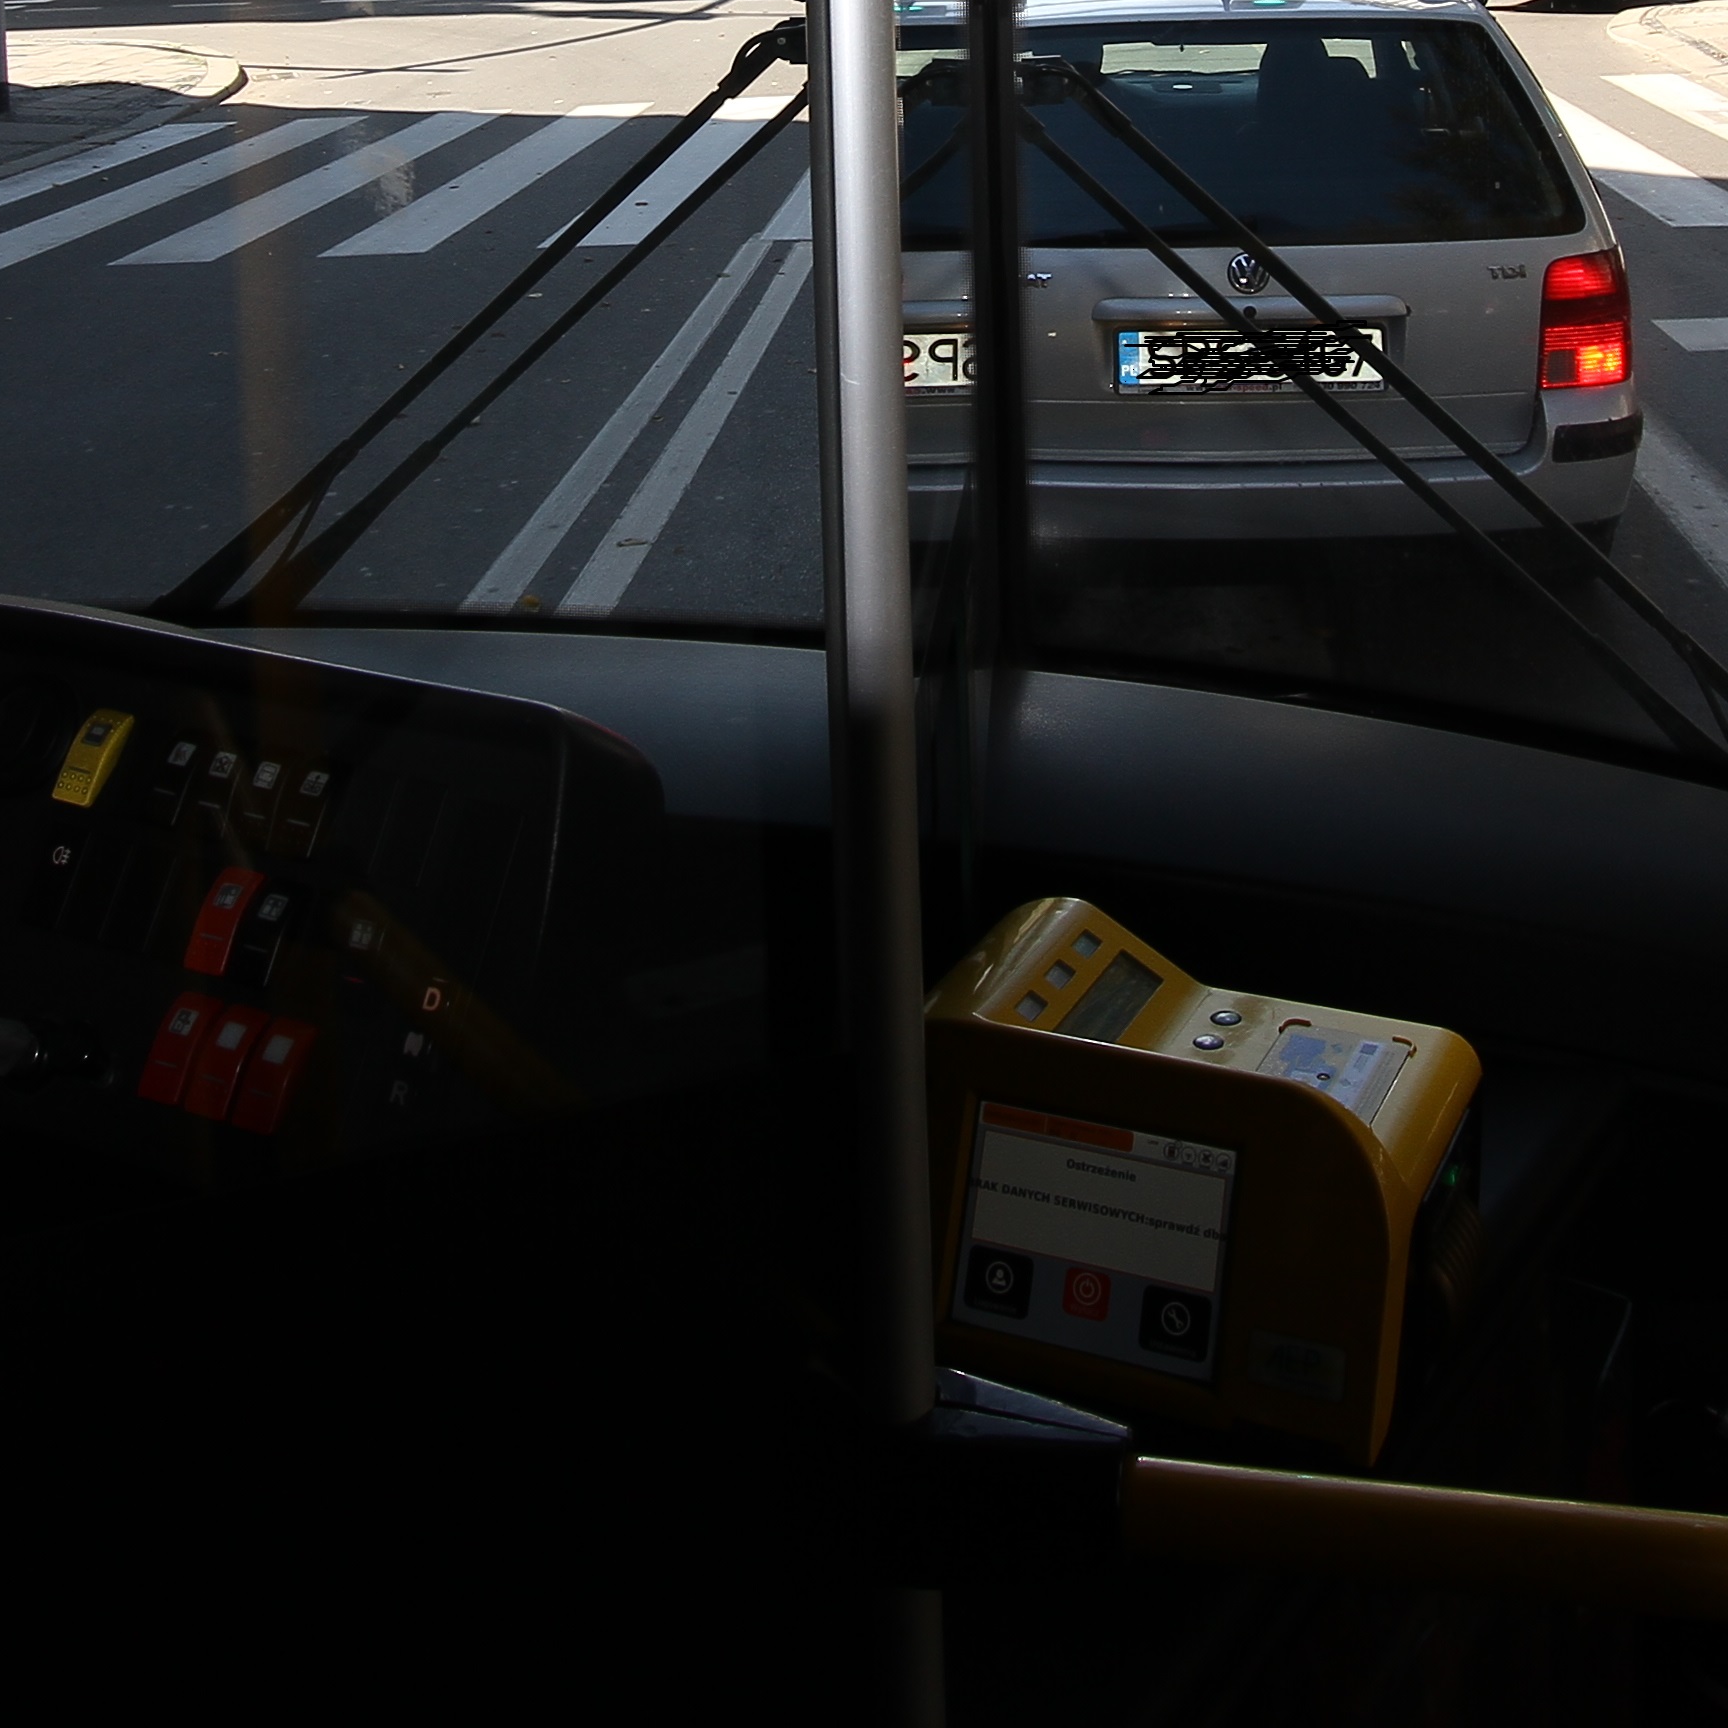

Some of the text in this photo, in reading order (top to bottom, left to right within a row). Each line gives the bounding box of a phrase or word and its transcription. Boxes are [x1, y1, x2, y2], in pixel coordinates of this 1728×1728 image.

[421, 985, 442, 1012] D
[388, 1079, 409, 1106] R
[1066, 1158, 1137, 1183] Ostrzeżenie
[1001, 1182, 1051, 1204] DANYCH
